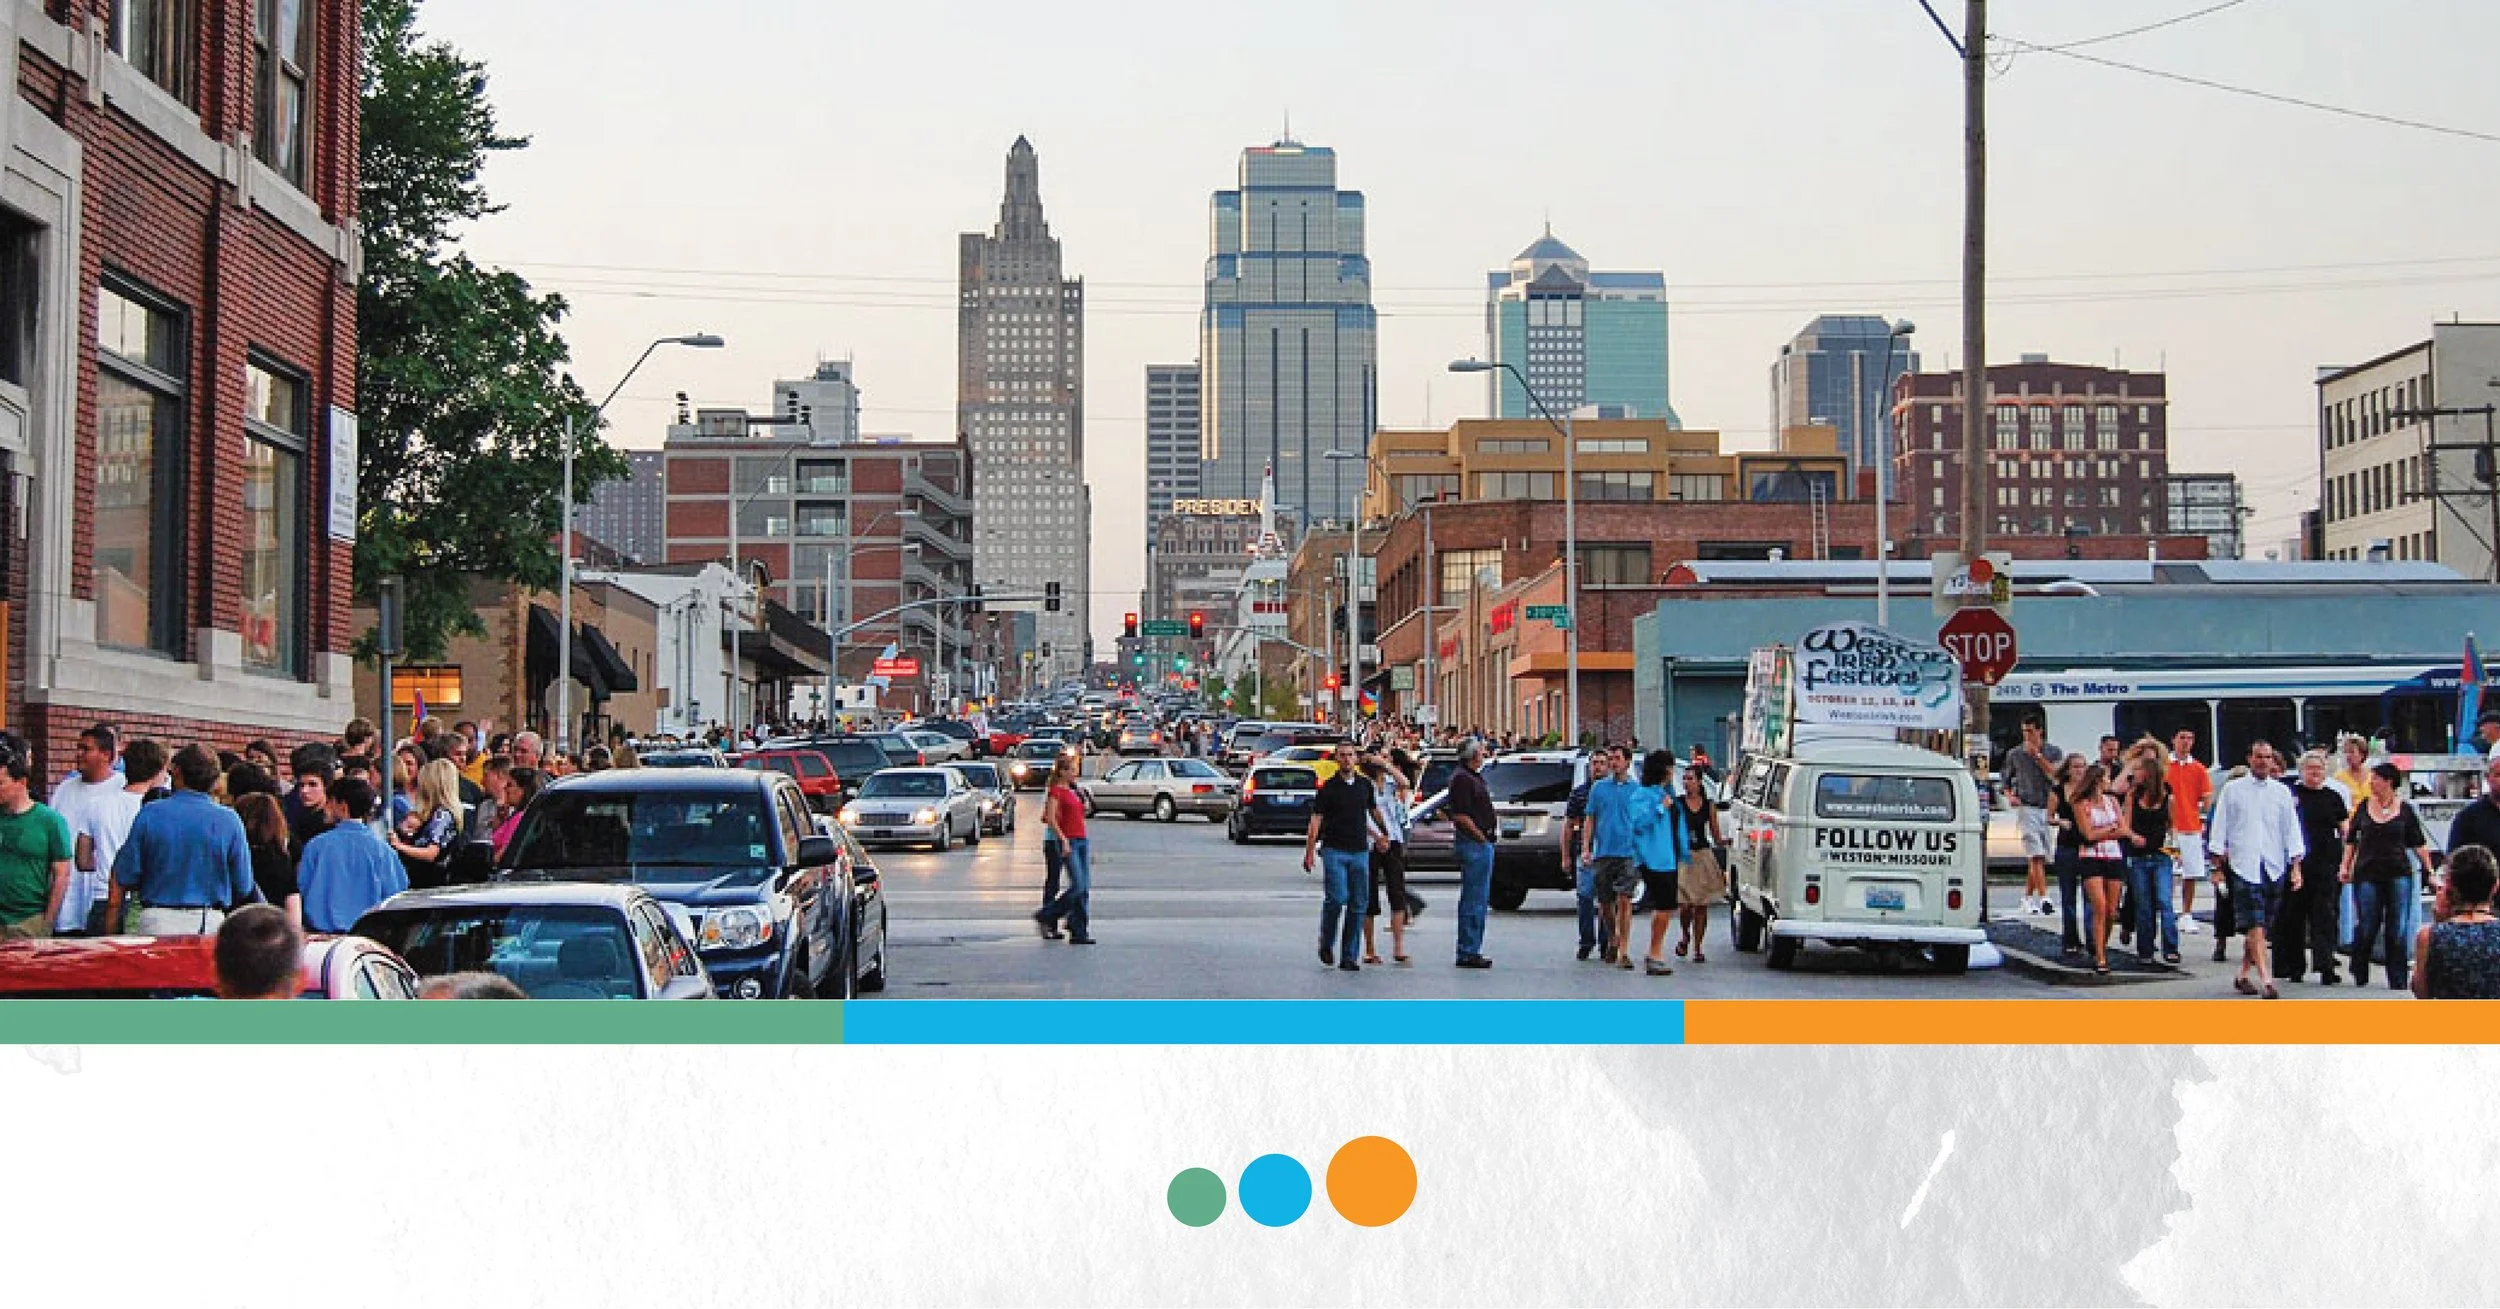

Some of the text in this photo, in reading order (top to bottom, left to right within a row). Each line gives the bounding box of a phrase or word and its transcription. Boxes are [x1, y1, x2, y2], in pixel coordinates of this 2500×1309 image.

[1173, 499, 1263, 515] PRESIDEN
[1945, 632, 2012, 662] STOP
[1803, 658, 1920, 691] Festival
[2050, 682, 2129, 695] The Metro
[1815, 827, 1957, 853] FOLLOW US
